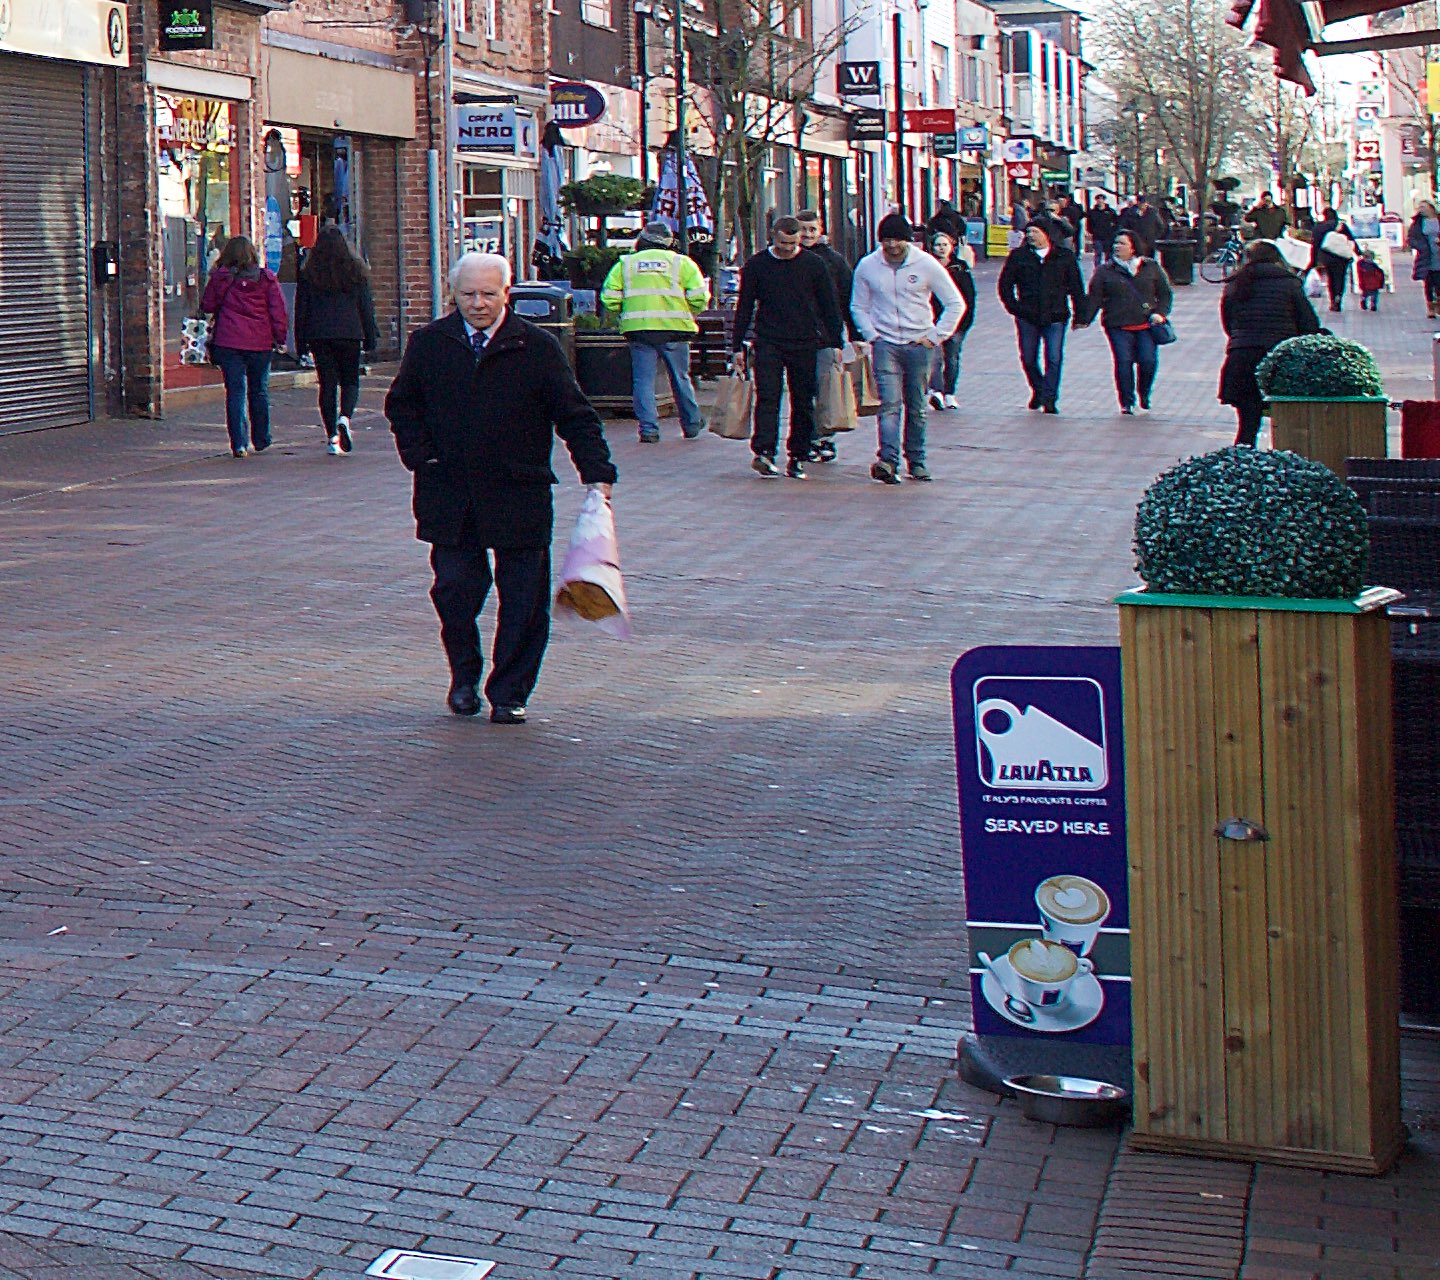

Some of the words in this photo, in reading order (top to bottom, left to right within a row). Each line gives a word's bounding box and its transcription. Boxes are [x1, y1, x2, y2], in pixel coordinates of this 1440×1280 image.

[848, 66, 874, 83] W
[549, 103, 589, 120] HILL
[458, 126, 512, 138] NERO
[998, 759, 1094, 783] LAVAZZA
[982, 794, 1019, 804] ITALY'S
[984, 818, 1059, 835] SERVED
[1062, 820, 1111, 836] HERE
